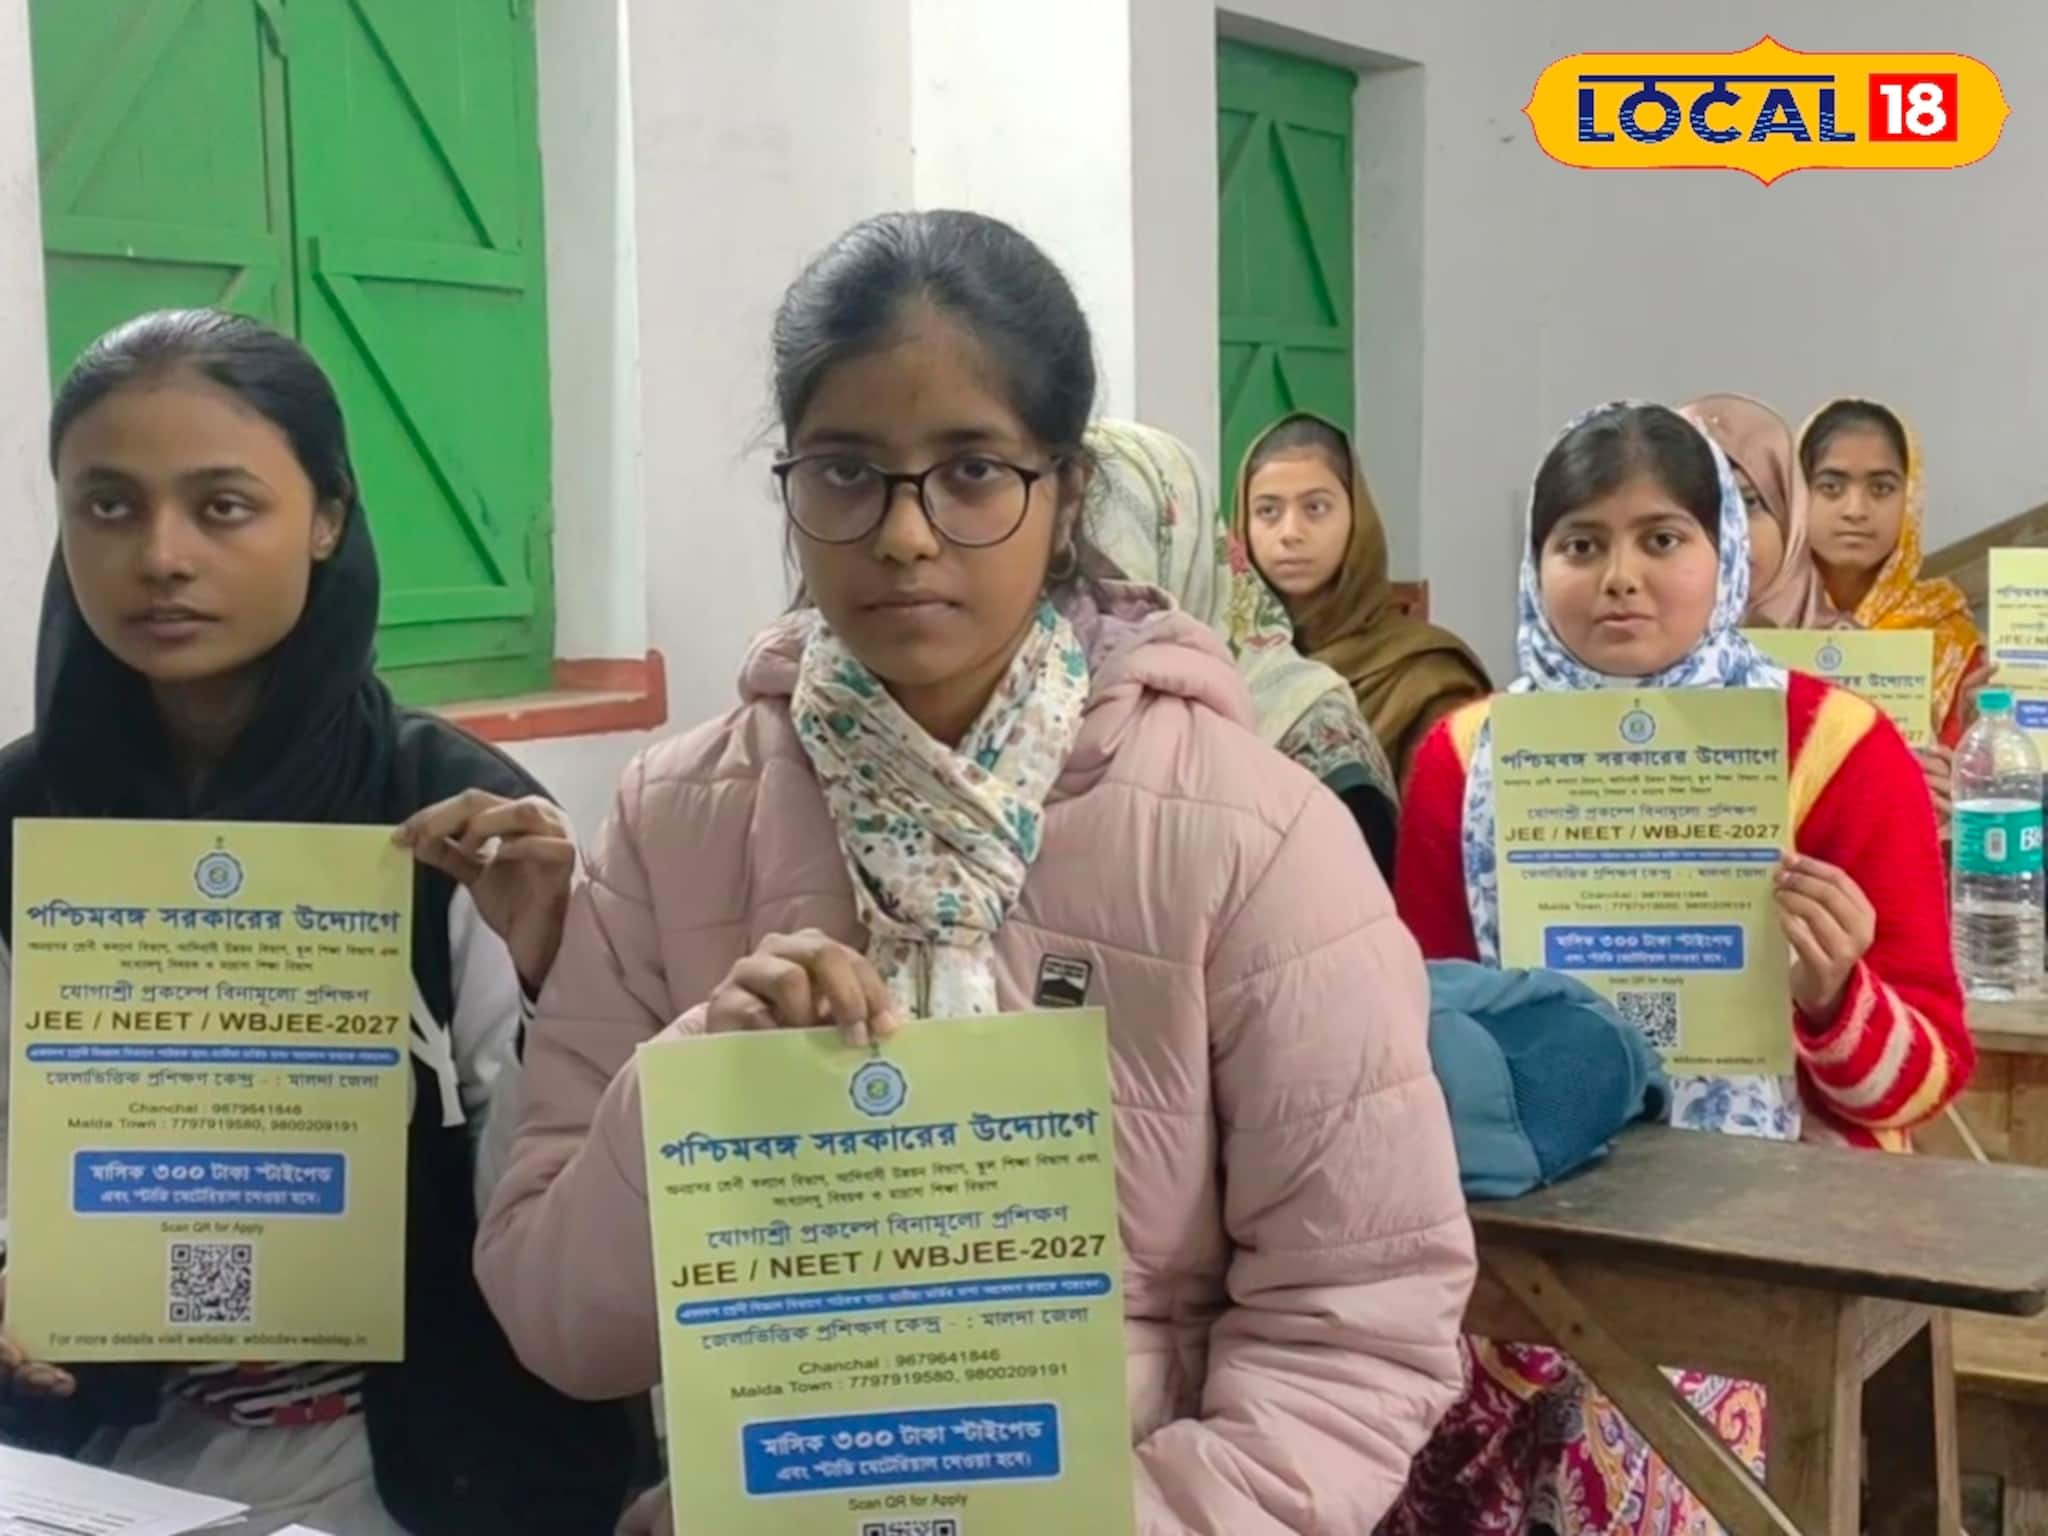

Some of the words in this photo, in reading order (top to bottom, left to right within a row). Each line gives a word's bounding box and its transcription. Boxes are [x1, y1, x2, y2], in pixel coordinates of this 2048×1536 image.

[1501, 748, 1586, 769] পশ্চিমবঙ্গ
[1596, 748, 1687, 767] সরকারের
[1696, 745, 1777, 766] উদ্যোগে
[1505, 826, 1545, 842] JEE
[1565, 825, 1623, 840] NEET
[1642, 824, 1781, 840] WBJEE-2027
[27, 899, 148, 929] পশ্চিমবঙ্গ
[158, 905, 282, 931] সরকারের
[295, 904, 400, 934] উদ্যোগে
[25, 1012, 83, 1031] JEE
[112, 1012, 192, 1031] NEET
[219, 1012, 399, 1035] WBJEE-2027
[119, 1118, 158, 1130] Town
[660, 1131, 799, 1167] পশ্চিমবঙ্গ
[812, 1121, 957, 1155] সরকারের
[969, 1108, 1098, 1142] উদ্যোগে
[152, 1163, 204, 1182] ৩০০
[209, 1161, 250, 1183] টাকা
[672, 1260, 738, 1288] JEE
[769, 1251, 861, 1279] NEET
[893, 1233, 1107, 1270] WBJEE-2027
[799, 1356, 879, 1376] Chanchal
[895, 1348, 1000, 1369] 9679641846
[731, 1383, 784, 1400] Malda
[788, 1378, 833, 1396] Town
[848, 1369, 959, 1390] 7797919580,
[965, 1362, 1069, 1382] 9800209191
[832, 1428, 895, 1450] ৩০০
[899, 1422, 946, 1445] টাকা
[848, 1496, 881, 1511] Scan
[885, 1494, 907, 1508] QR
[910, 1493, 928, 1506] for
[932, 1491, 969, 1508] Apply
